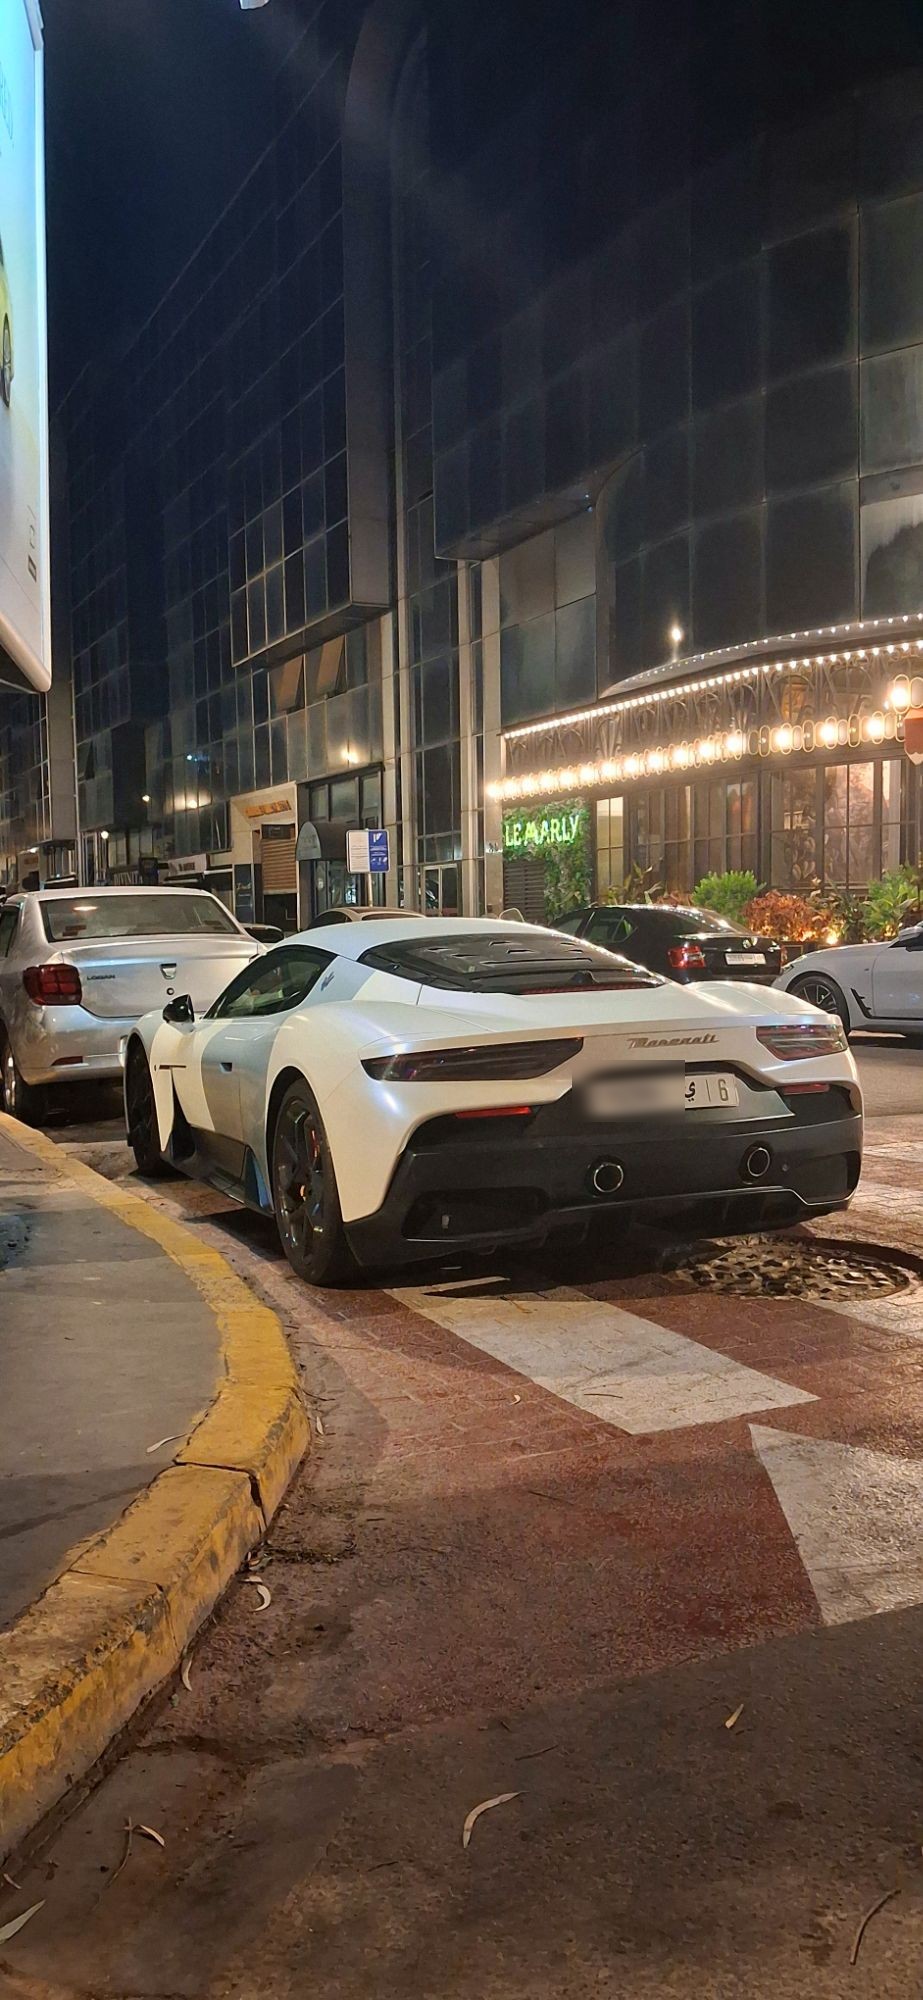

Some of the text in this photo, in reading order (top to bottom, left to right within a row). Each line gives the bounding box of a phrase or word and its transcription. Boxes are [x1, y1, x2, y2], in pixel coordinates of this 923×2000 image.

[505, 814, 580, 847] LE MARLY
[626, 1033, 720, 1050] Maserati
[718, 1078, 729, 1102] 6
